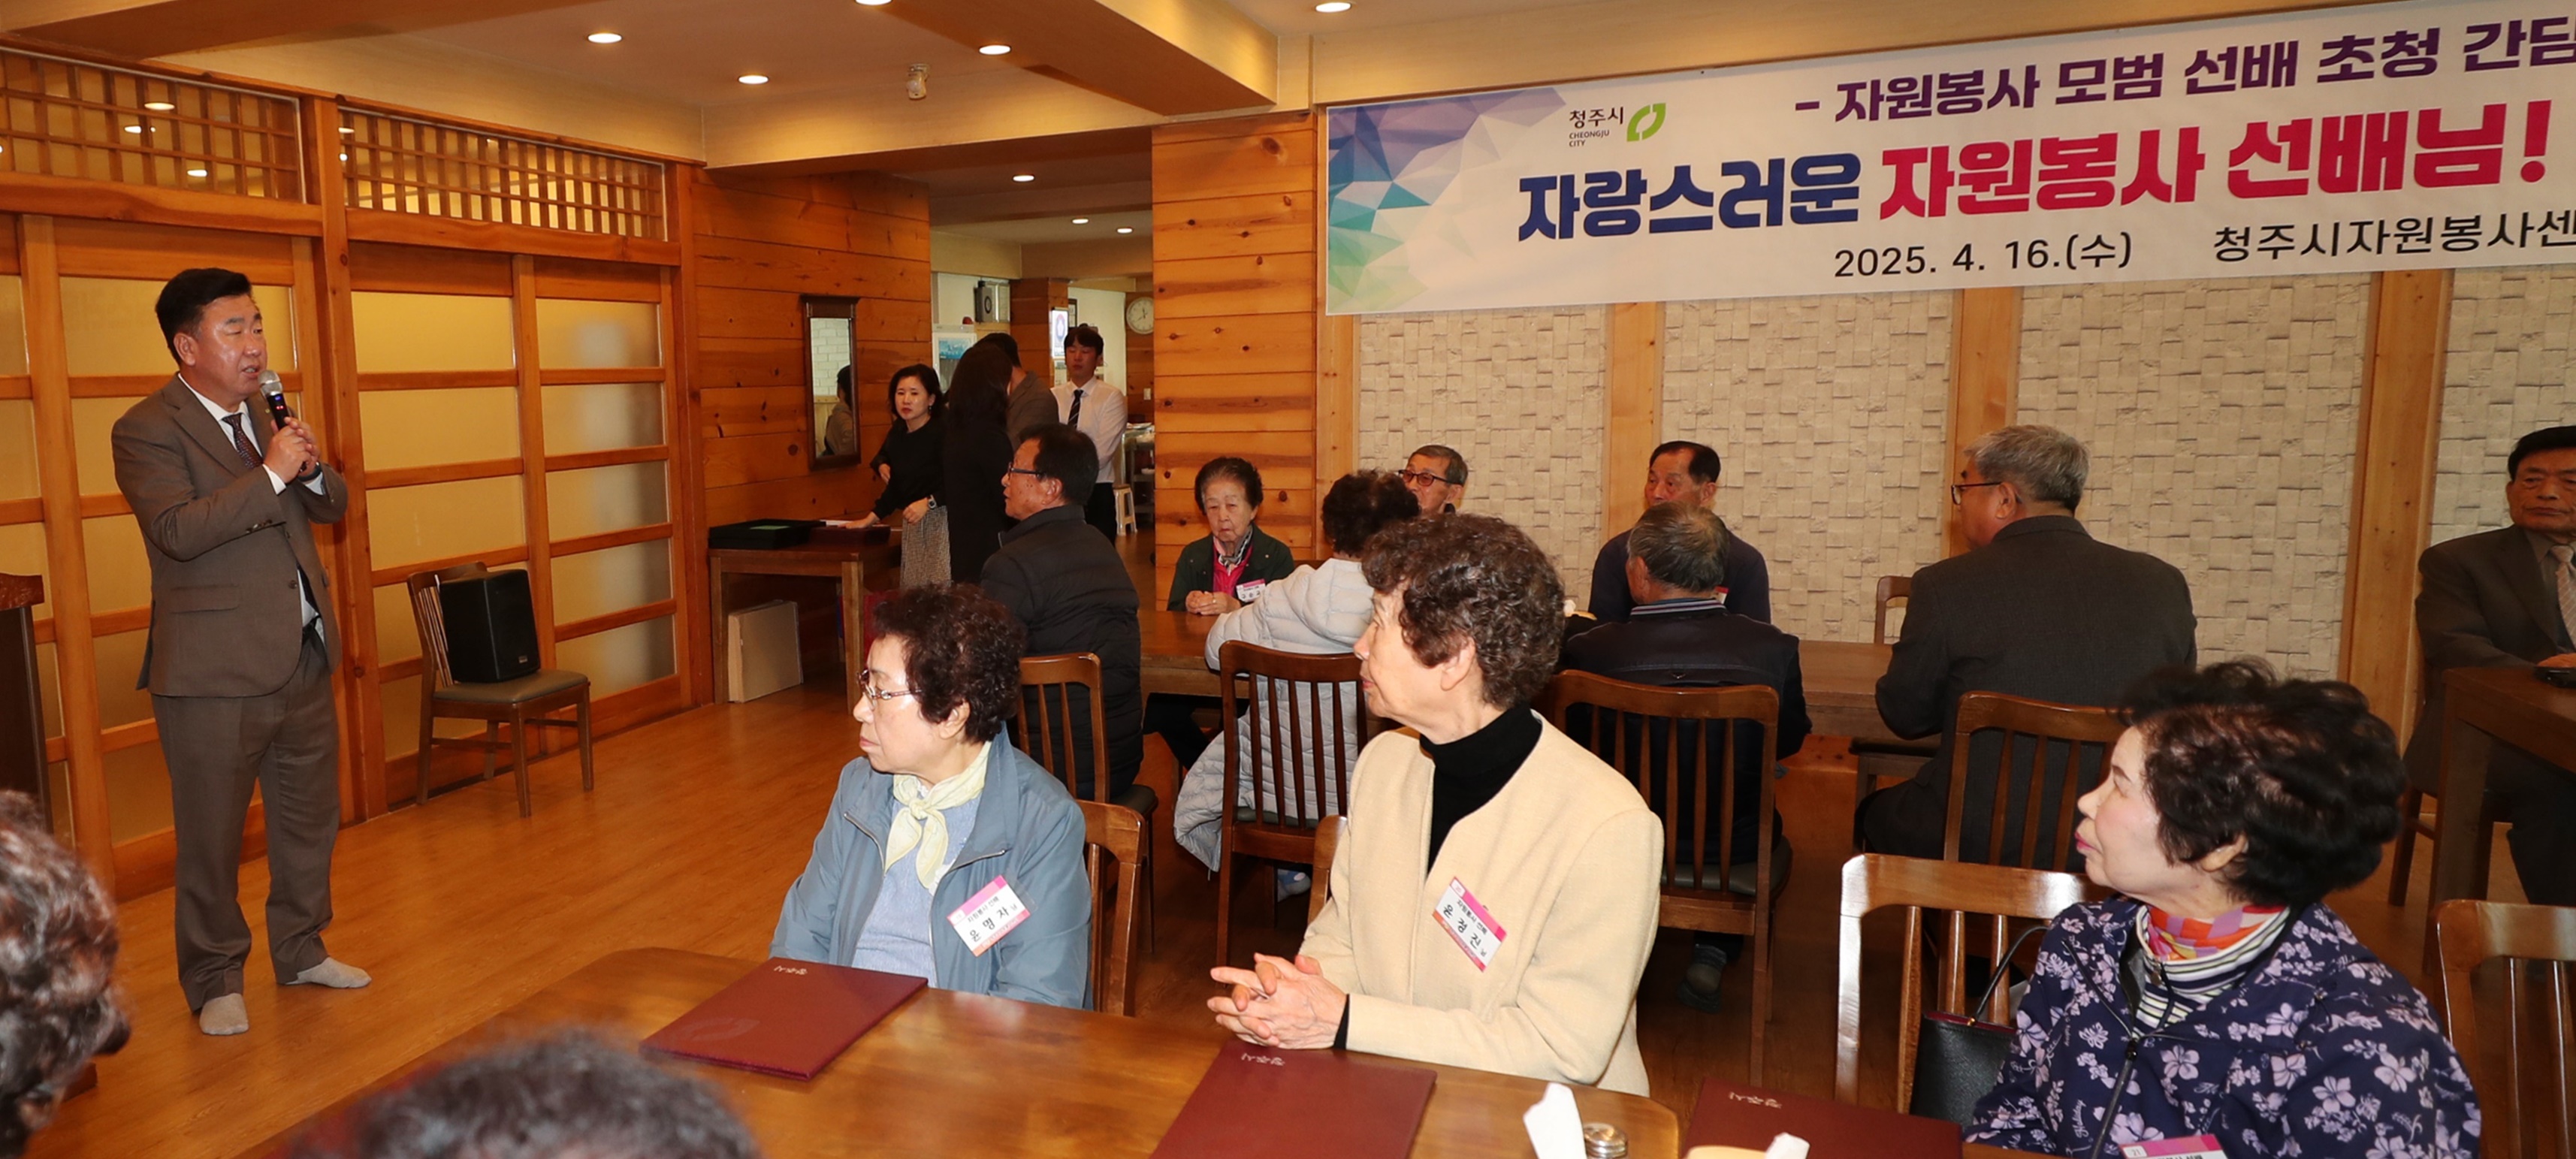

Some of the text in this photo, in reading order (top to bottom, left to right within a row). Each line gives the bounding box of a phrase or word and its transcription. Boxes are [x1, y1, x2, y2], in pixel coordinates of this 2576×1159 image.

[1835, 64, 2041, 122] 자원봉사
[2055, 52, 2164, 106] 모범
[2184, 40, 2300, 95] 선배
[2316, 27, 2441, 83] 초청
[1569, 106, 1624, 128] 청주시
[1569, 130, 1610, 140] CHEONGJU
[1518, 99, 2553, 242] 자랑스러운 자원봉사 선배님!
[1834, 231, 2132, 277] 2025. 4. 16.(수)
[2213, 210, 2576, 263] 청주시자원봉사센
[2072, 1099, 2088, 1138] Holiday
